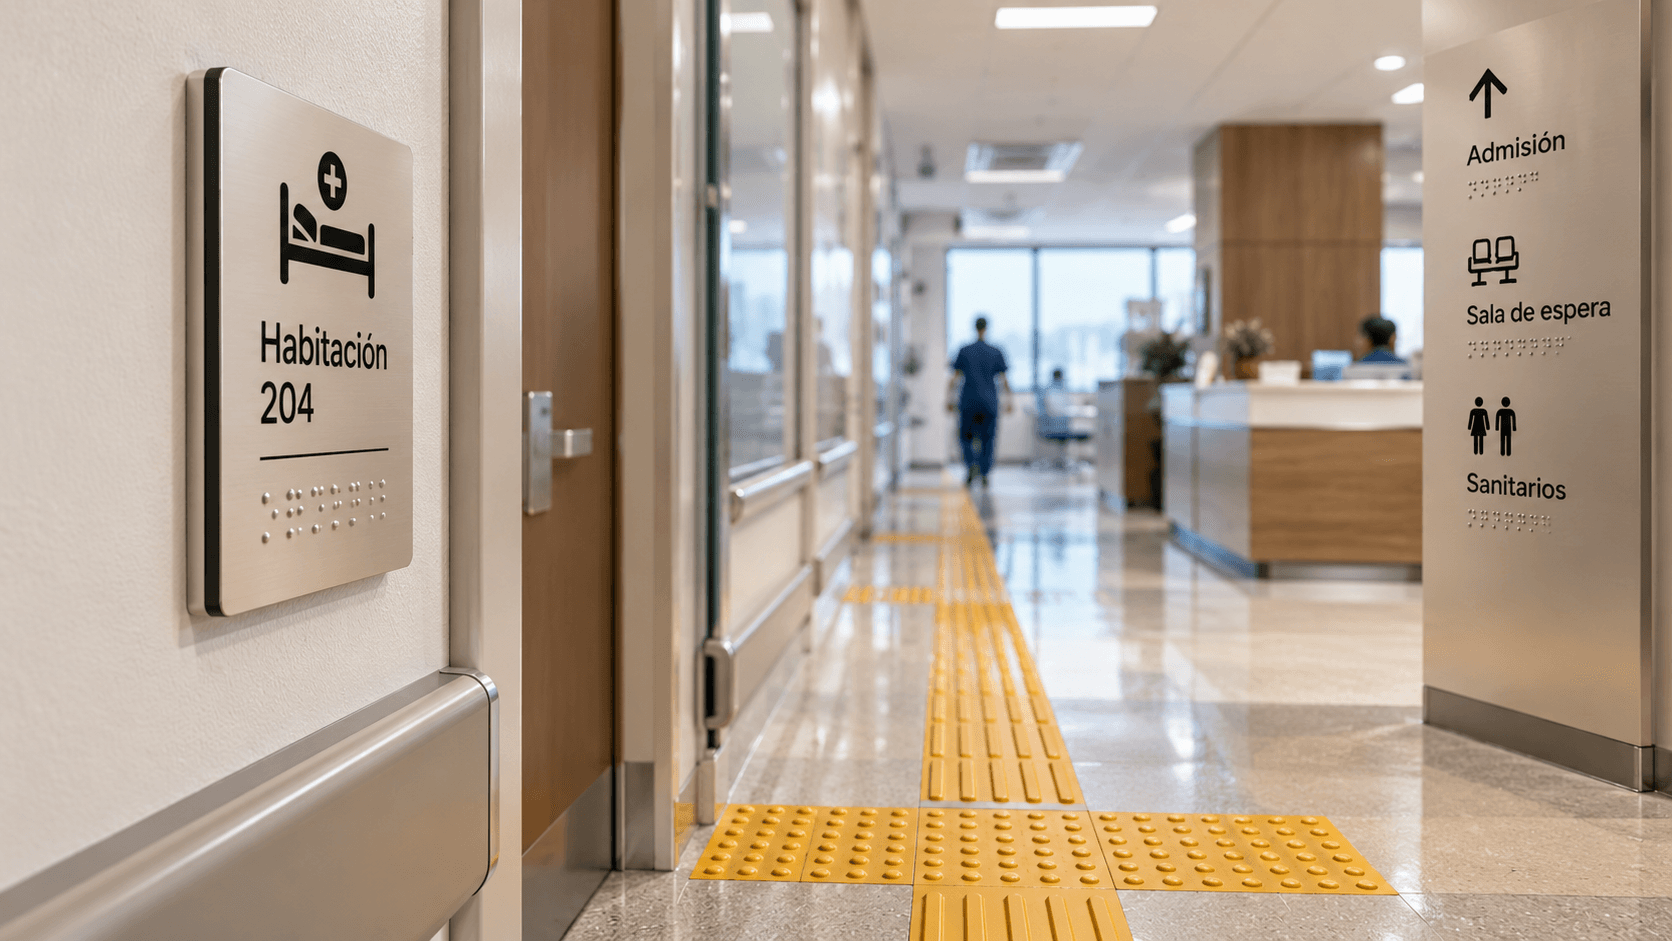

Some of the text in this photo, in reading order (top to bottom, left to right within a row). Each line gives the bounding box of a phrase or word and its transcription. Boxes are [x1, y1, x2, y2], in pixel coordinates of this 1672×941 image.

[1466, 130, 1566, 167] Admisión
[1466, 300, 1612, 326] Sala de espera
[261, 320, 388, 371] Habitación
[260, 380, 315, 425] 204
[1466, 472, 1567, 501] Sanitarios
